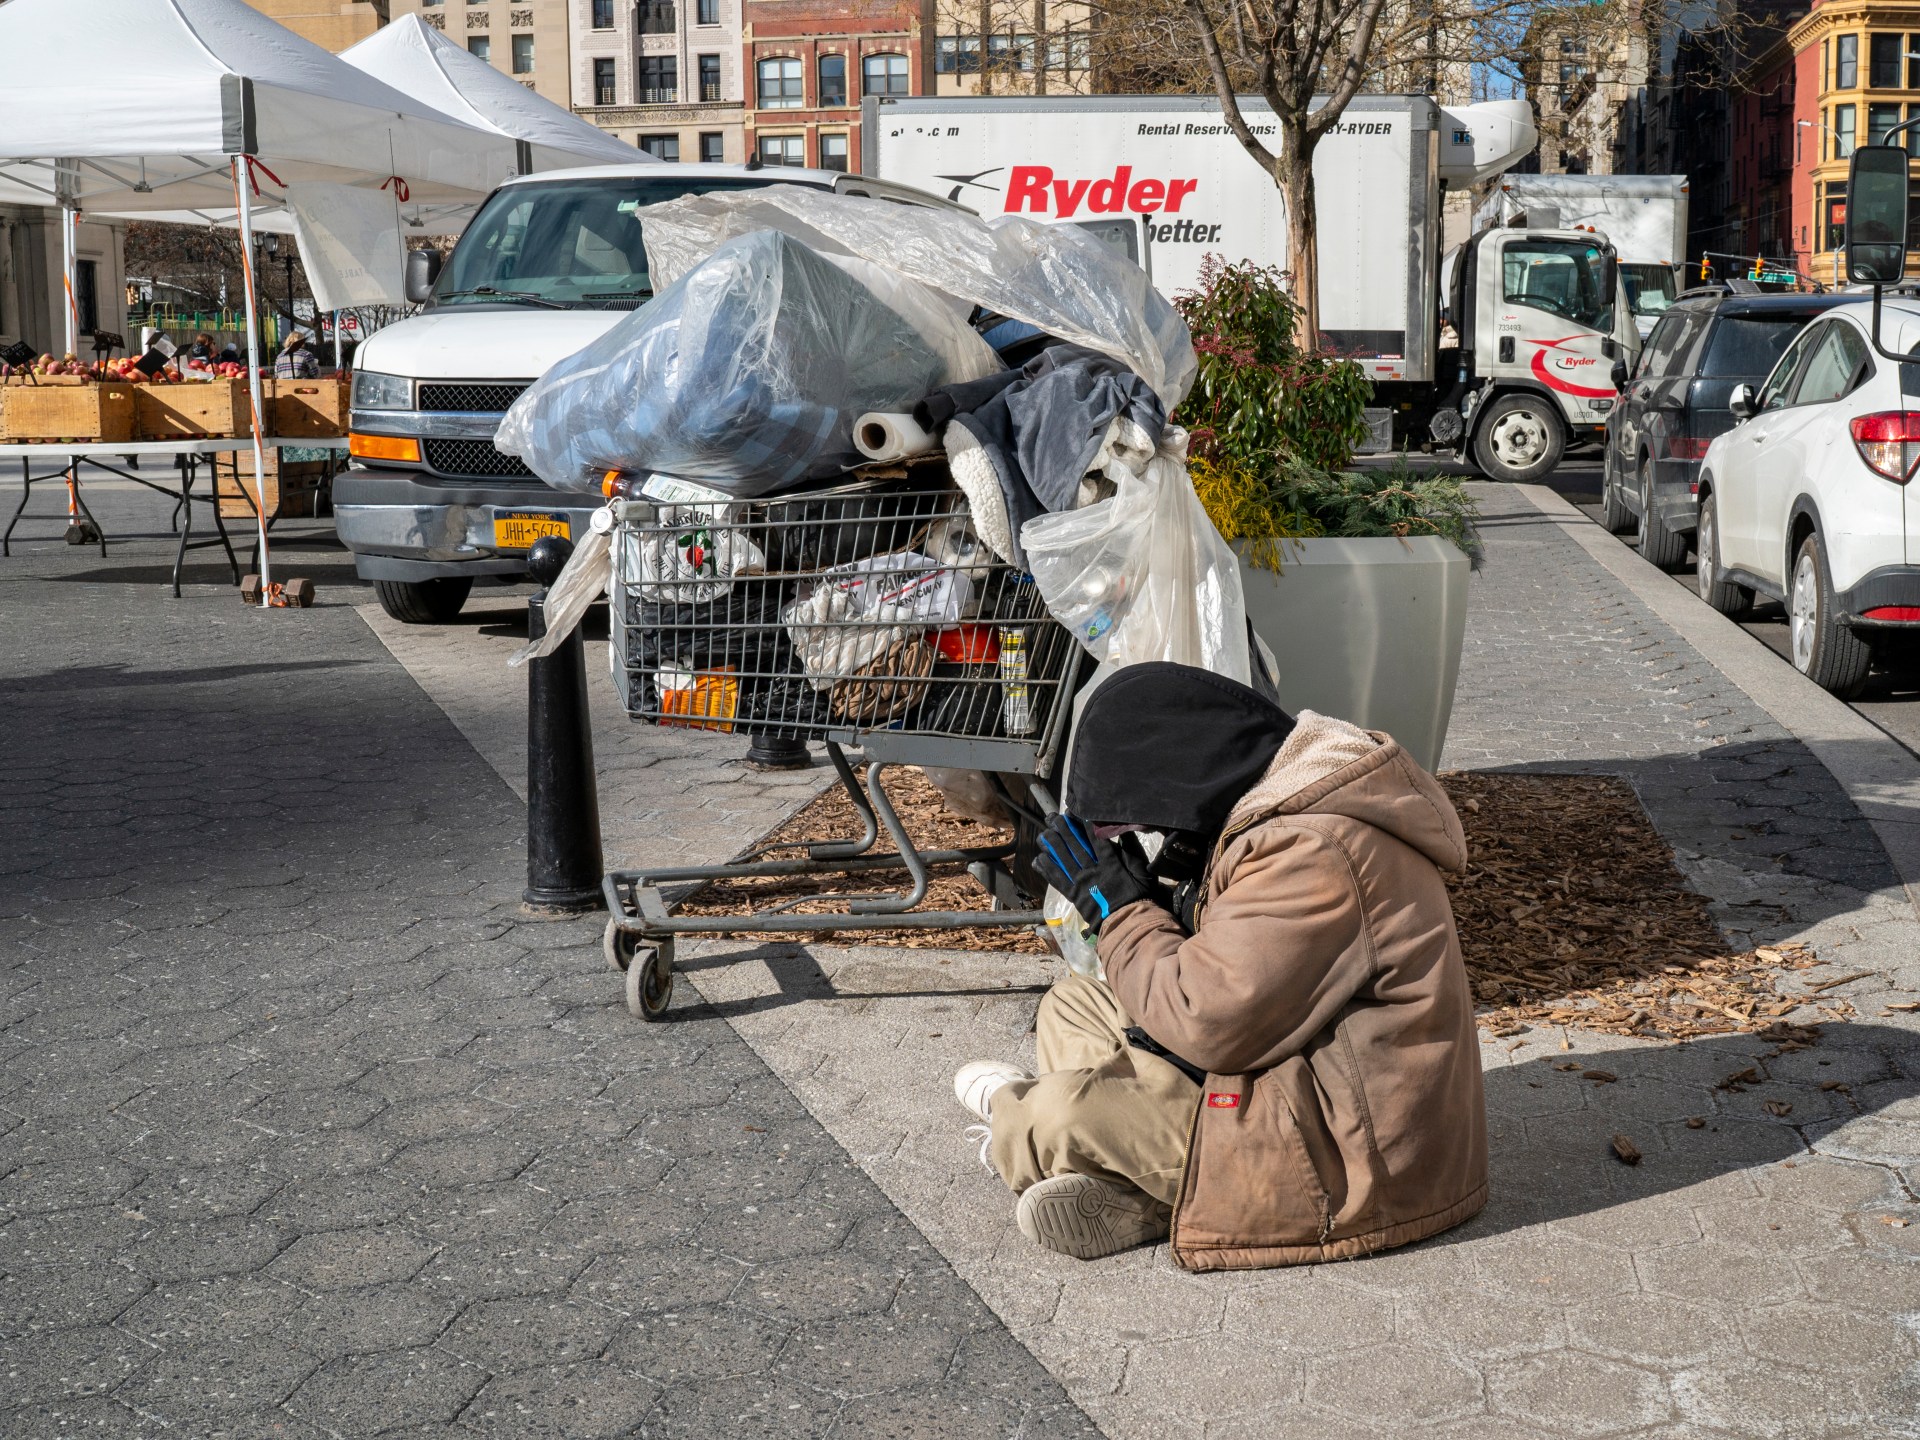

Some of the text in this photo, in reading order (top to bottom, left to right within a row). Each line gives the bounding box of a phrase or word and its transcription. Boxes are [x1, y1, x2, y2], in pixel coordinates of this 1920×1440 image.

[1137, 123, 1276, 135] Rental Reservons:
[1004, 165, 1198, 219] Ryder
[1498, 323, 1522, 332] 733493
[1565, 357, 1597, 368] Ryder
[512, 512, 551, 521] NEW YORK
[503, 522, 525, 541] JHH
